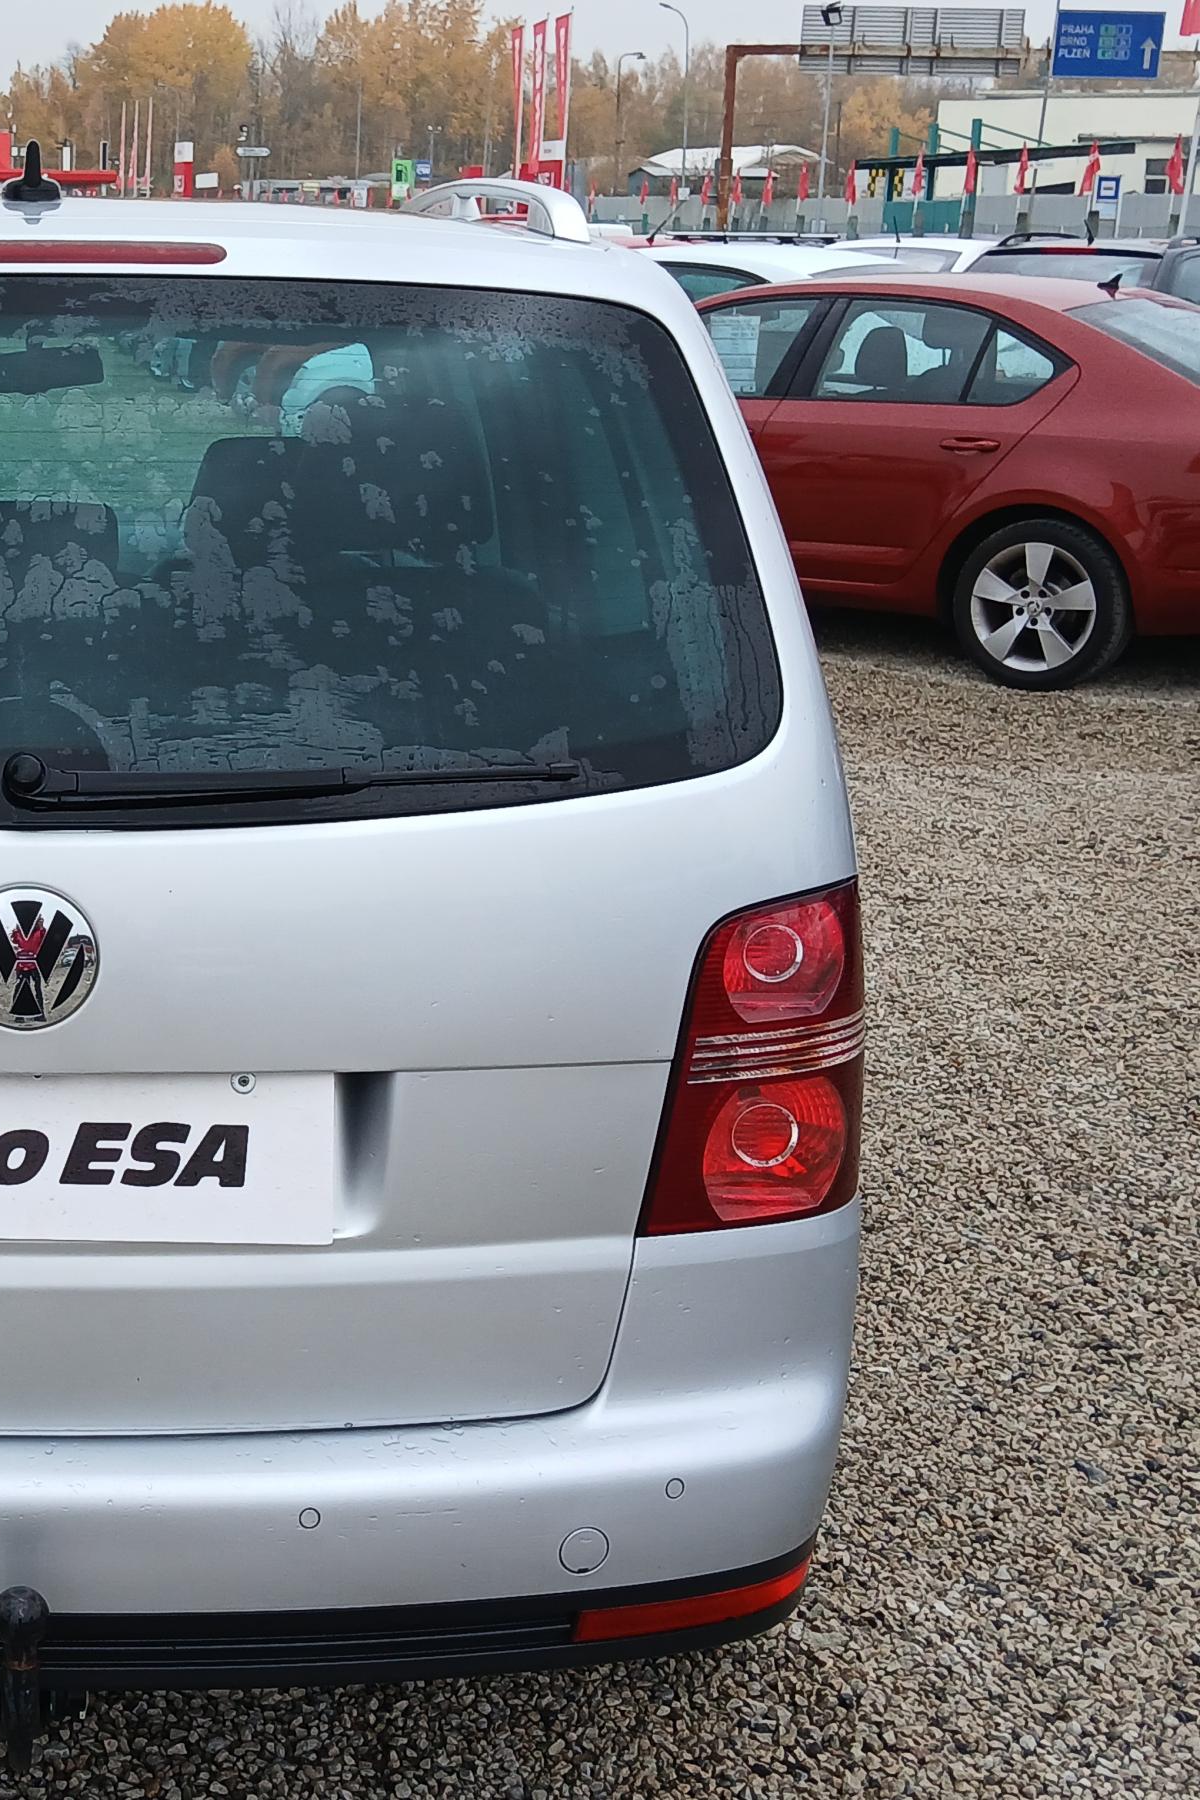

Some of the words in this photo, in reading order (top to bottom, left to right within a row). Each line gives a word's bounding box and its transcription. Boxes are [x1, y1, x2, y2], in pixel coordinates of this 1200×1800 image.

[1061, 24, 1095, 34] PRAHA
[1060, 36, 1087, 46] BRNO
[59, 1122, 249, 1187] ESA
